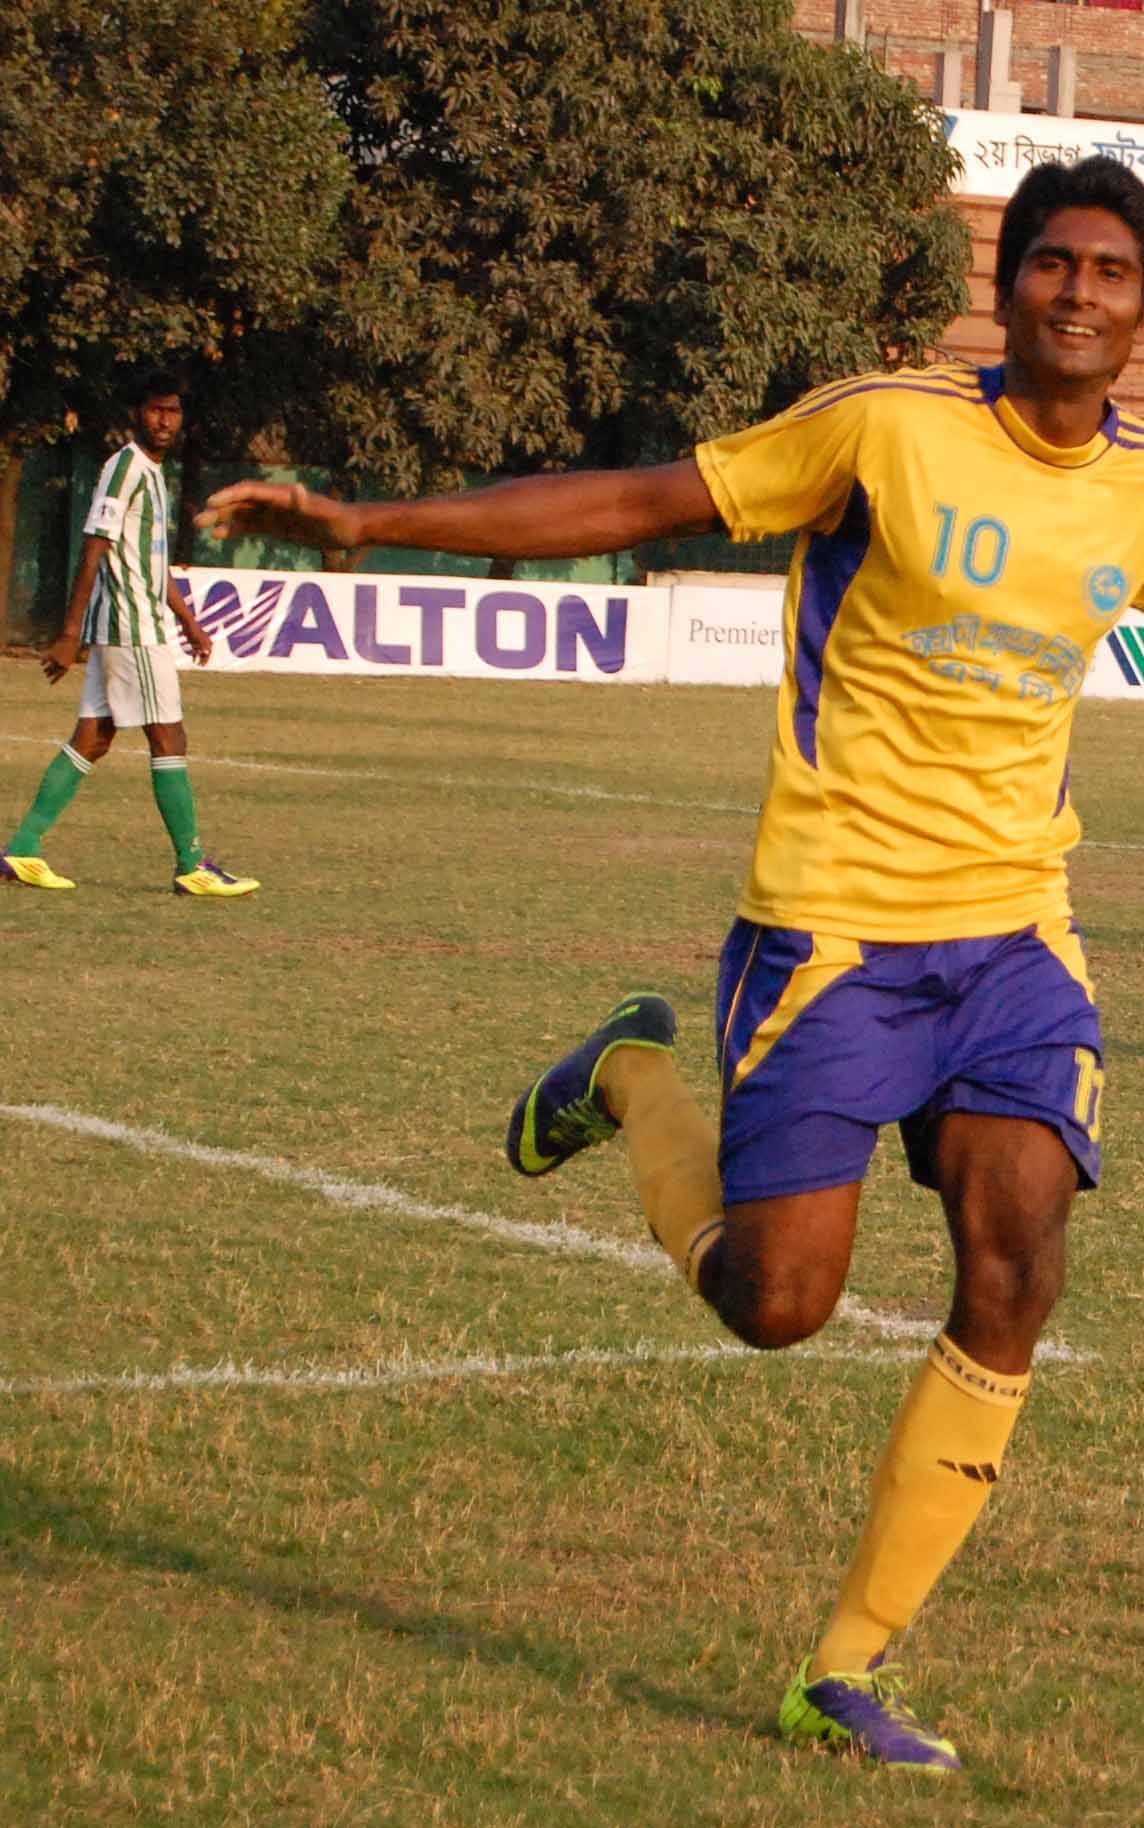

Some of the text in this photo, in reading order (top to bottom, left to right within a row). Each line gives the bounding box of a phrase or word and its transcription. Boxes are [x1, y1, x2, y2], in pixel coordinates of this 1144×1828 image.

[929, 501, 1010, 588] 10
[174, 577, 630, 674] WALTON
[687, 617, 781, 646] Premier
